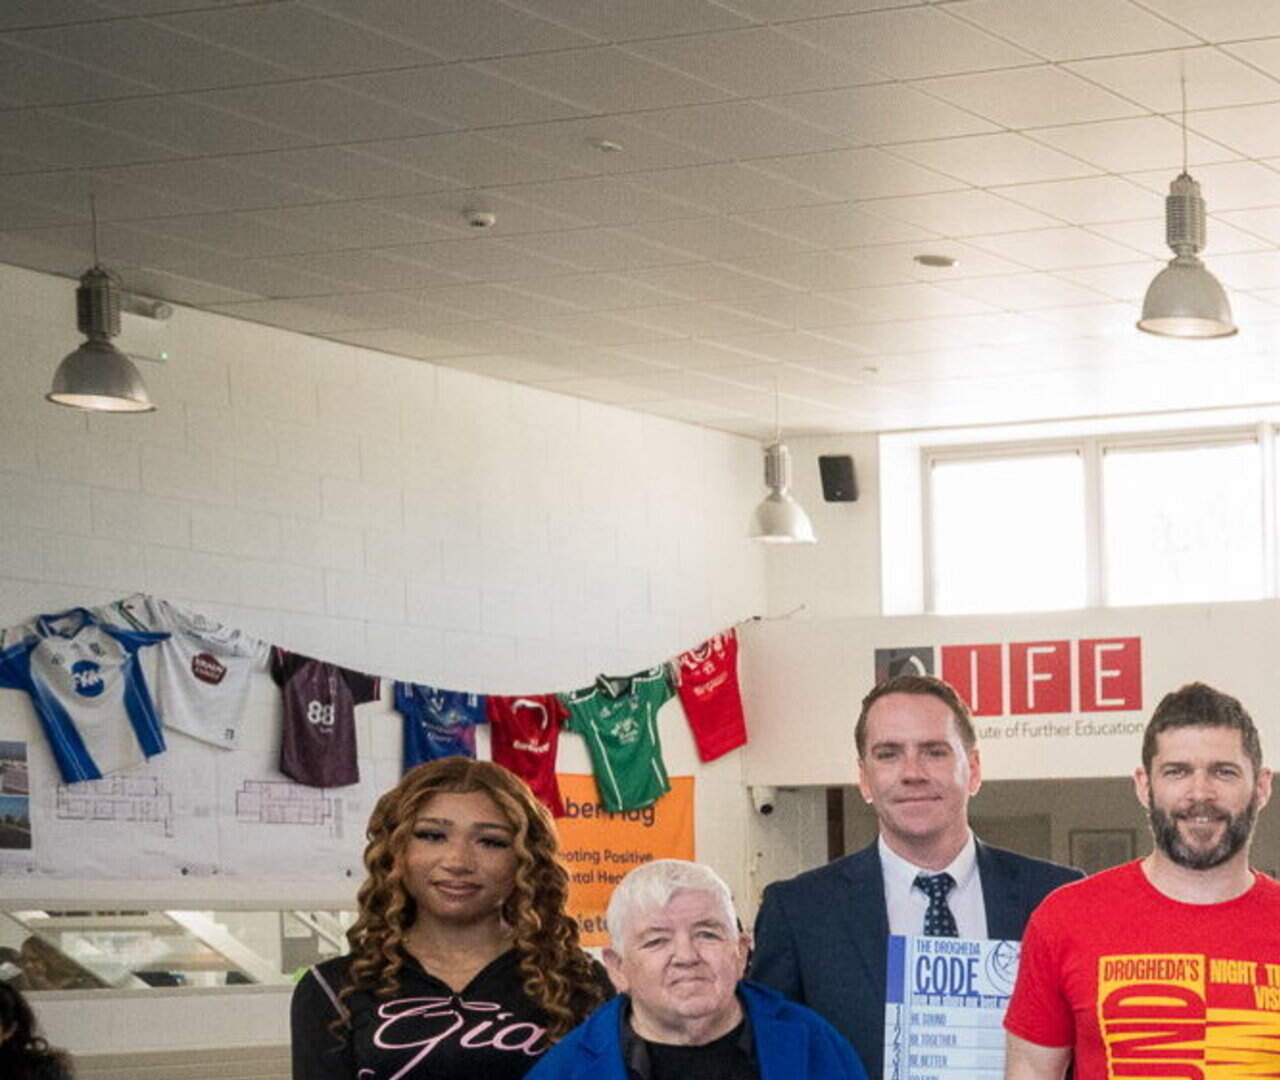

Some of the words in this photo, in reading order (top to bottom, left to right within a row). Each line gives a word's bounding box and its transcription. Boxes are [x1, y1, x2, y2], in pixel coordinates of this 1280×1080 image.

[308, 700, 335, 726] 88
[1005, 724, 1018, 739] of
[1022, 722, 1070, 738] Further
[1074, 720, 1144, 737] Education
[565, 797, 602, 819] ber
[604, 849, 654, 863] Positive
[916, 955, 980, 995] CODE
[1104, 959, 1200, 982] DROGHEDA'S
[1209, 958, 1256, 985] NIGHT
